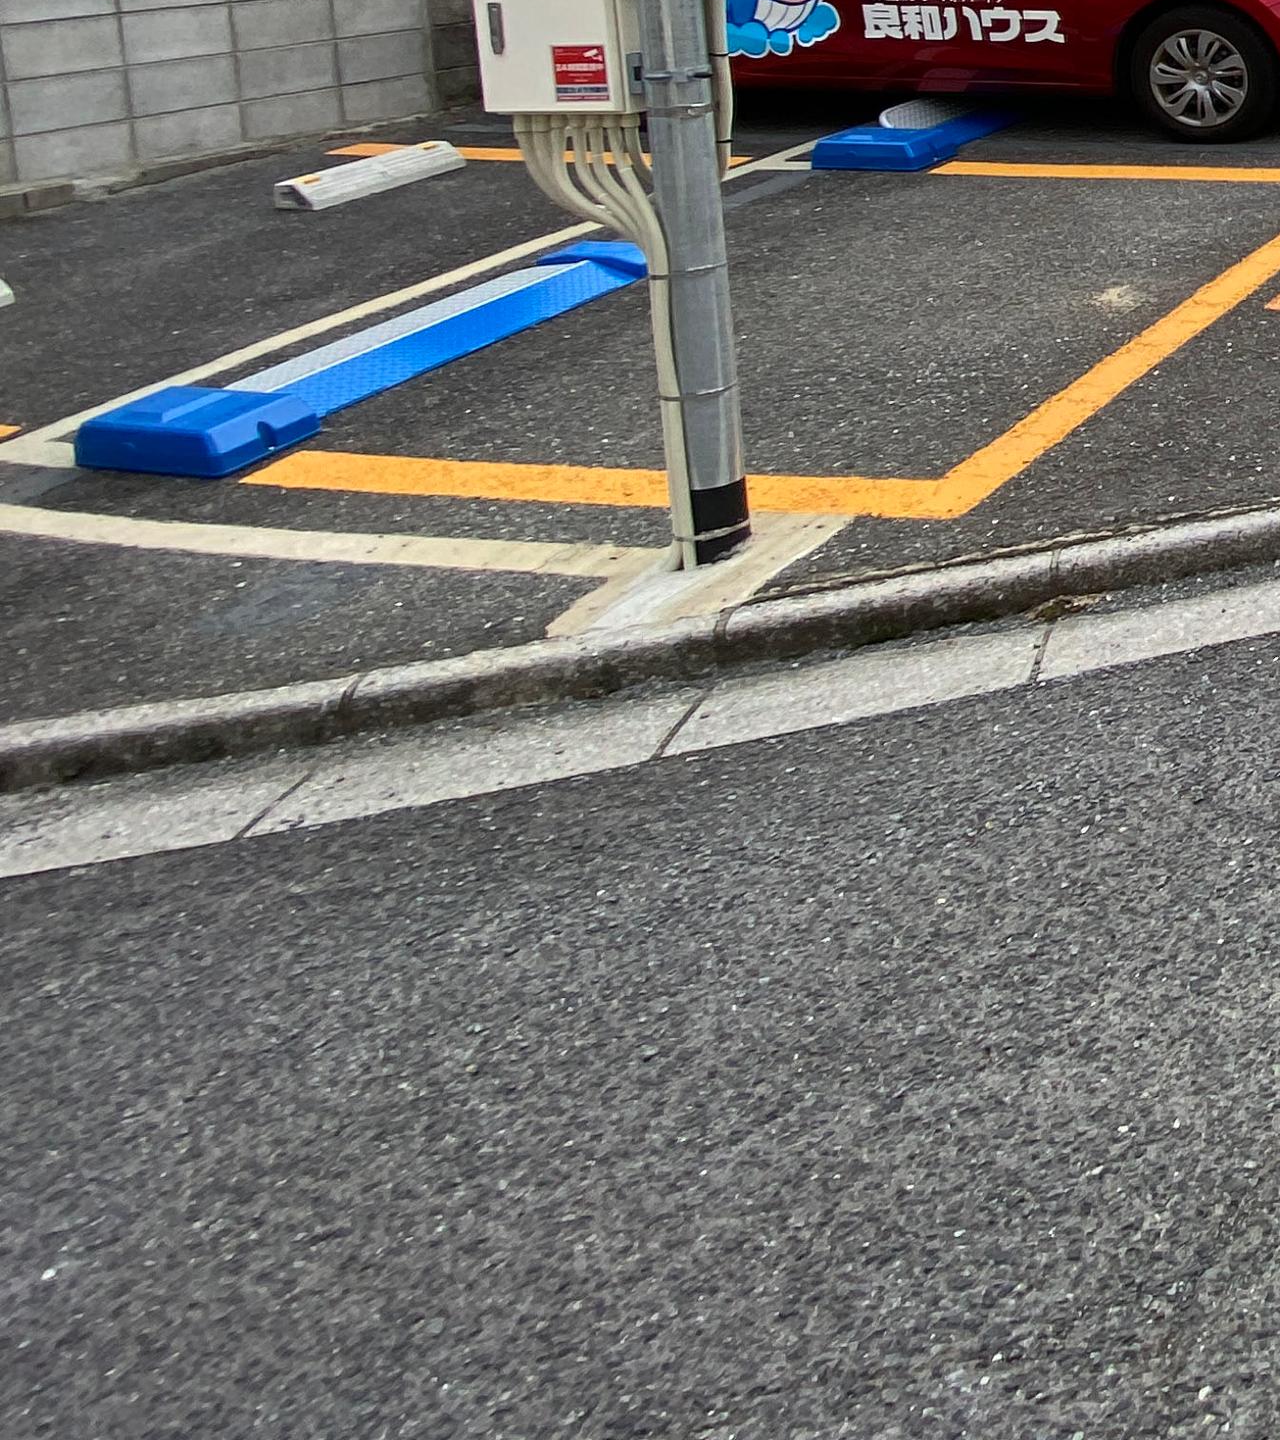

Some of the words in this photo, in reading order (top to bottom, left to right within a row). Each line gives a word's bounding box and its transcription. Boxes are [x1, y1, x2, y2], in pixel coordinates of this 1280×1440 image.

[862, 3, 1066, 43] 良和ハウス
